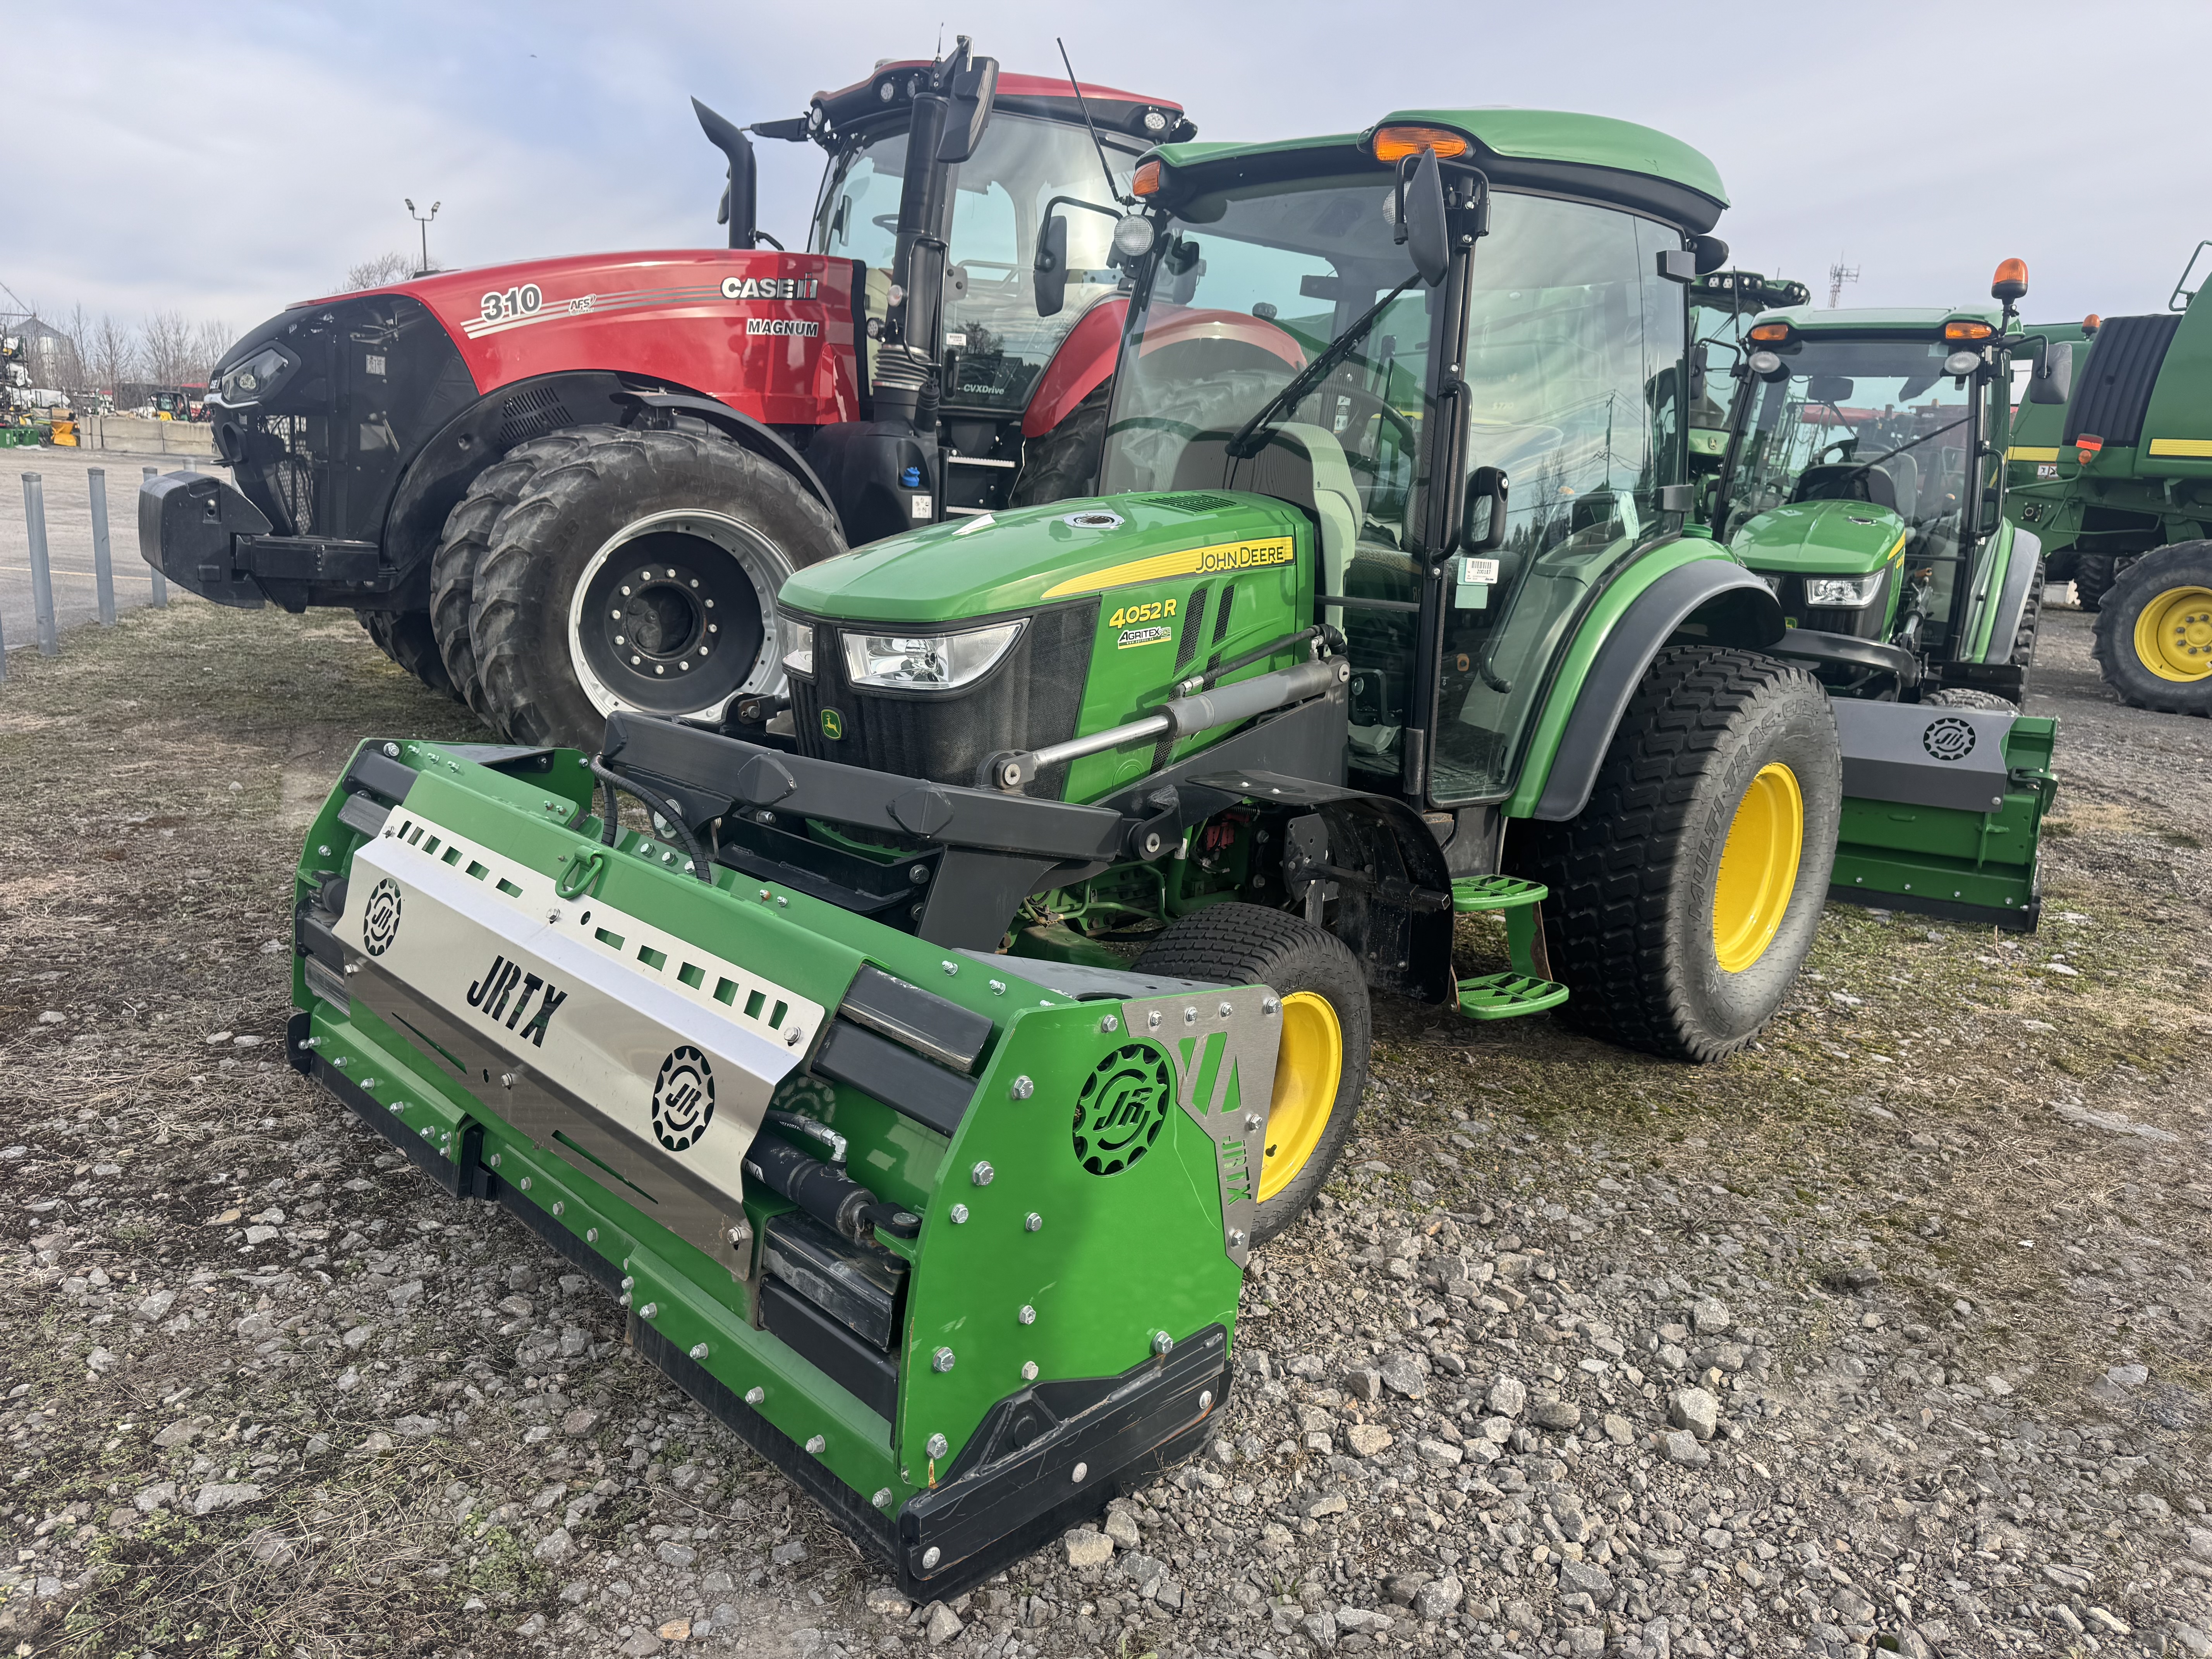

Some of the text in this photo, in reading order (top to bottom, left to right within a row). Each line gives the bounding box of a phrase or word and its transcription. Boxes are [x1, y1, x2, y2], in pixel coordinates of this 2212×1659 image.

[721, 276, 794, 299] CASE
[482, 285, 541, 321] 310
[570, 298, 590, 310] AFS
[747, 319, 818, 337] MAGNUM
[963, 384, 1005, 395] CVXDrive
[1195, 546, 1284, 571] JOHN DEERE
[1119, 628, 1160, 642] AGRITEX
[1688, 794, 1725, 921] MULTI
[1723, 709, 1776, 792] TRAC
[371, 905, 393, 930] JR
[466, 955, 568, 1048] JRTX
[665, 1082, 702, 1117] JR
[1221, 1135, 1252, 1206] JRTX
